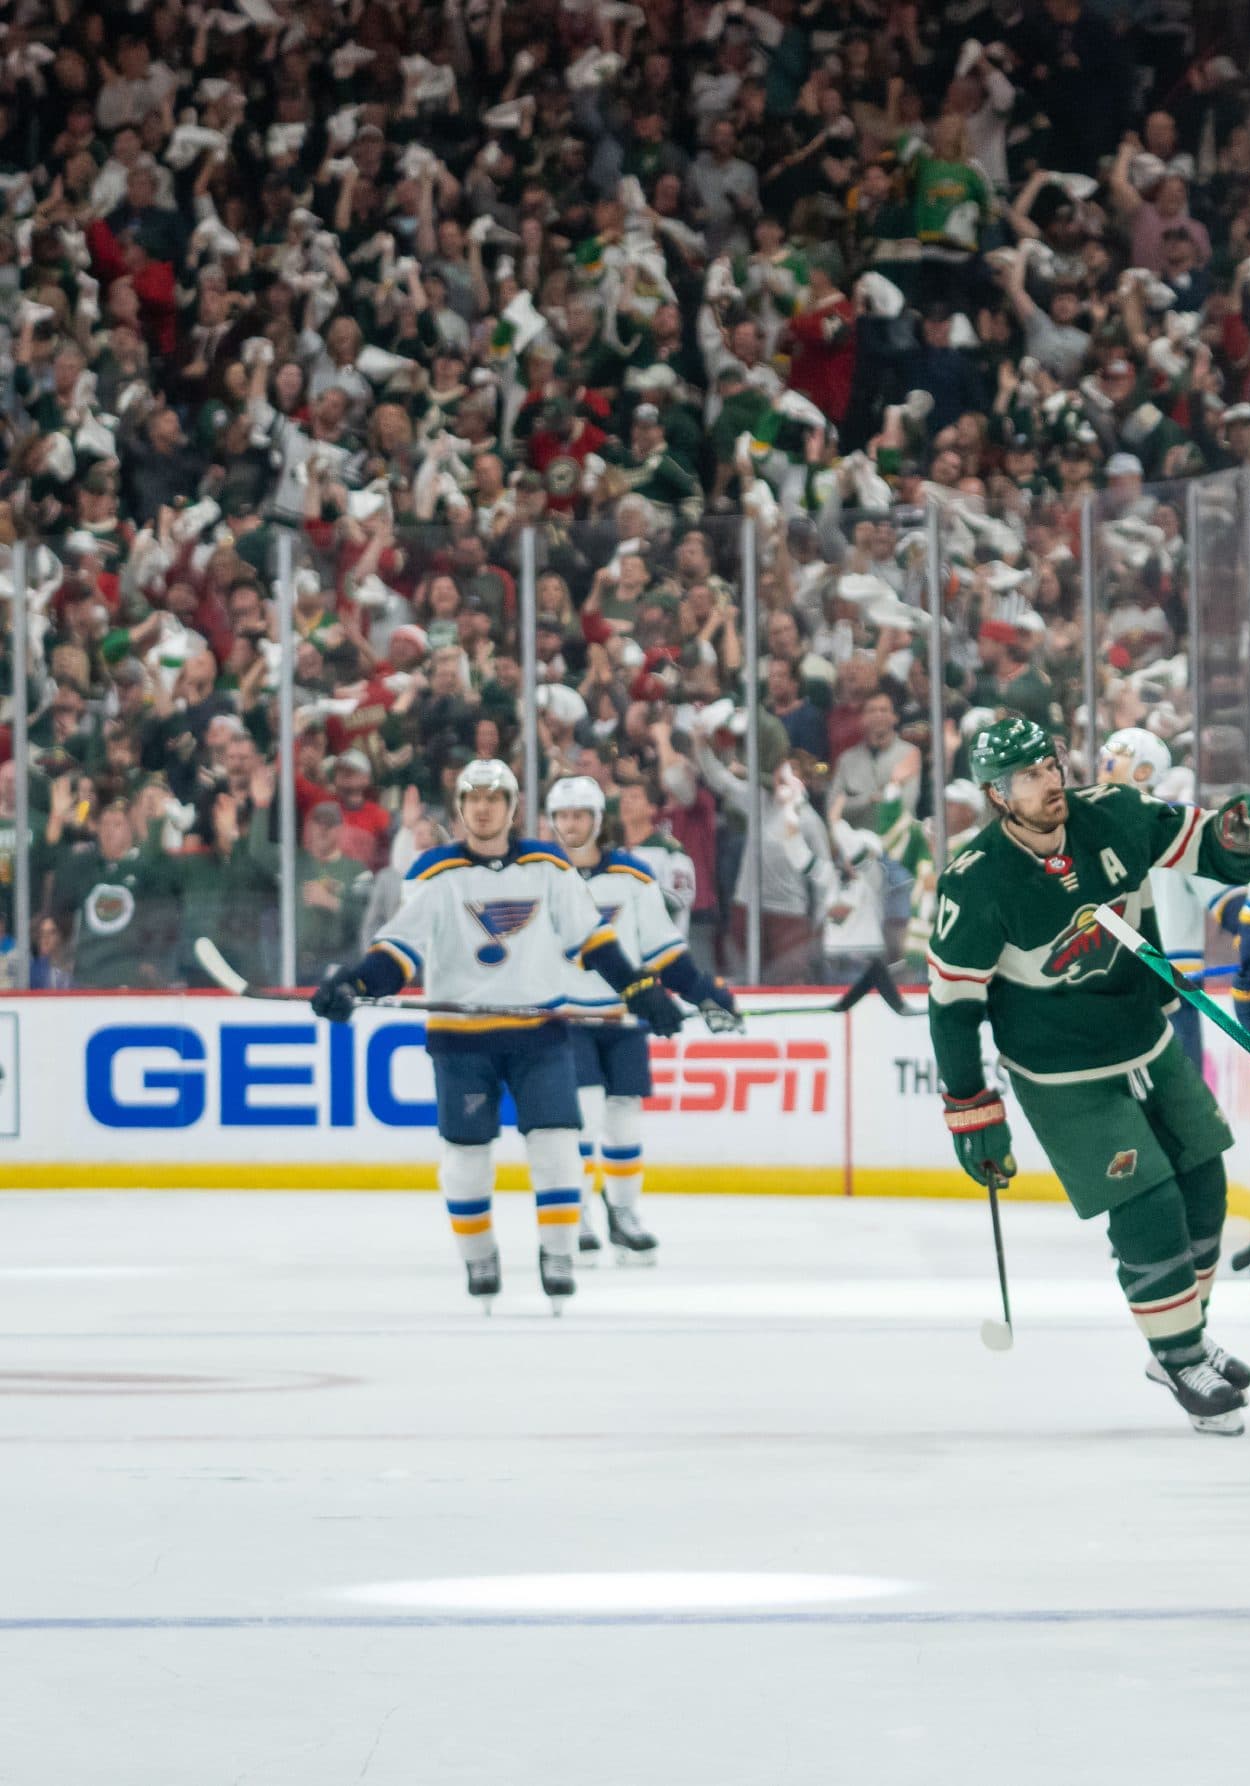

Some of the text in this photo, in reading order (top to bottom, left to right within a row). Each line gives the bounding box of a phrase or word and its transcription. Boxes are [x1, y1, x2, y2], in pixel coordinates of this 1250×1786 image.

[1100, 847, 1128, 886] A
[85, 1023, 518, 1128] GEIC
[641, 1042, 830, 1112] ESPN
